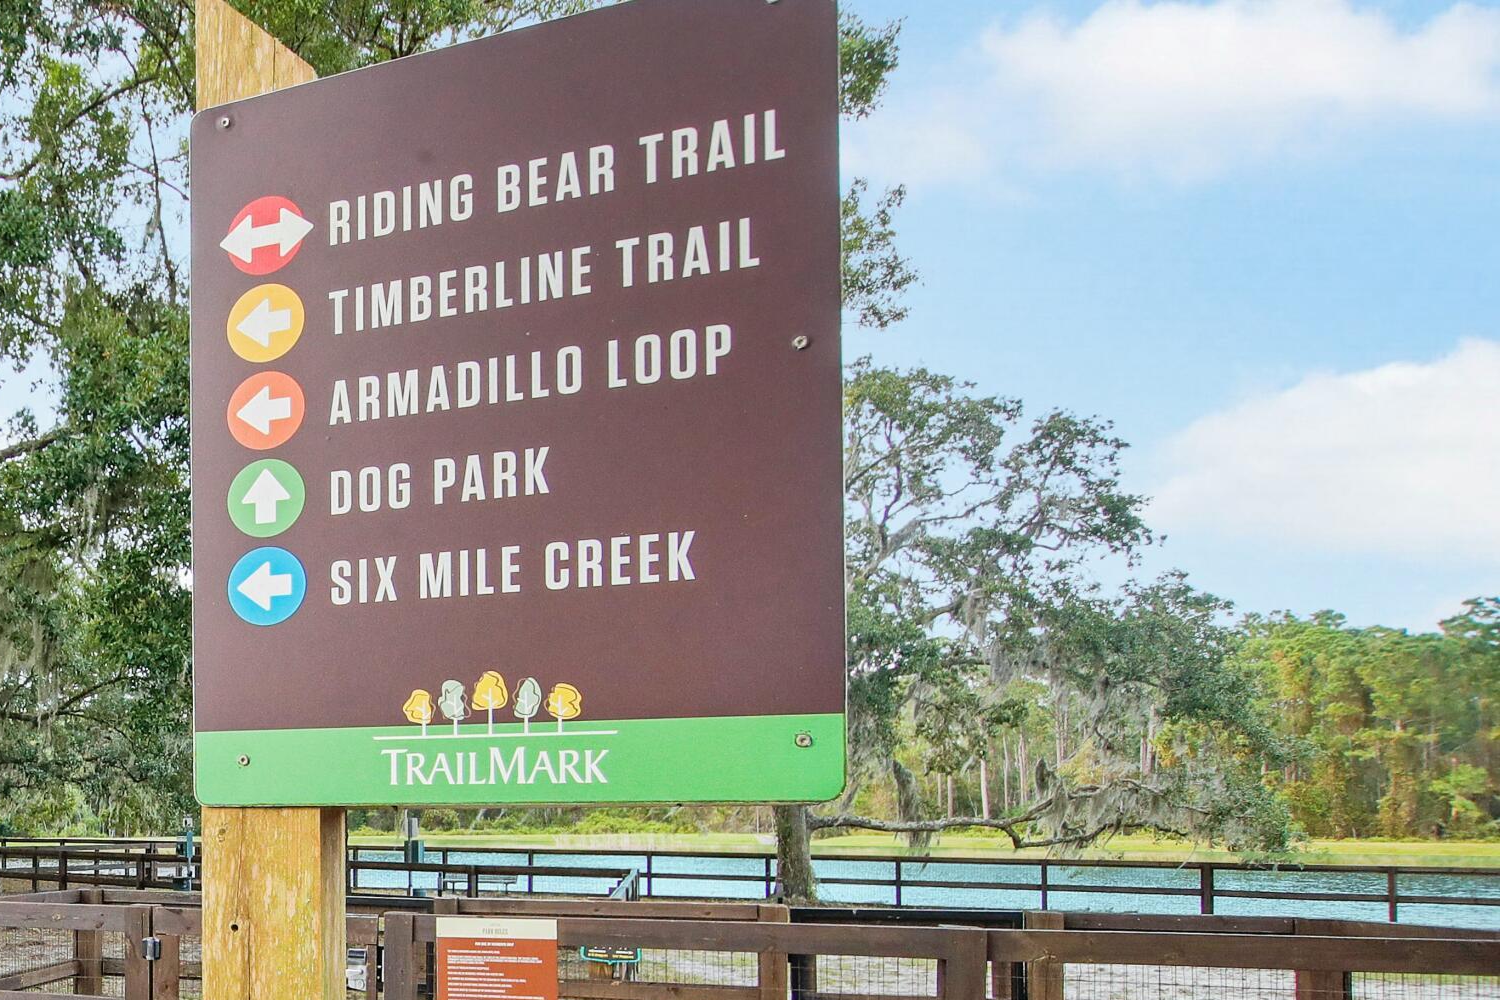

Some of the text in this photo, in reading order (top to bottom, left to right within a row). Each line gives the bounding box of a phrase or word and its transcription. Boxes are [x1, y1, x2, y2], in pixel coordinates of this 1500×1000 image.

[329, 109, 786, 247] RIDING BEAR TRAIL
[329, 217, 760, 336] TIMBERLINE TRAIL
[329, 324, 732, 426] ARMADILLO LOOP
[330, 445, 550, 516] DOG PARK
[330, 530, 696, 606] SIX MILE CREEK
